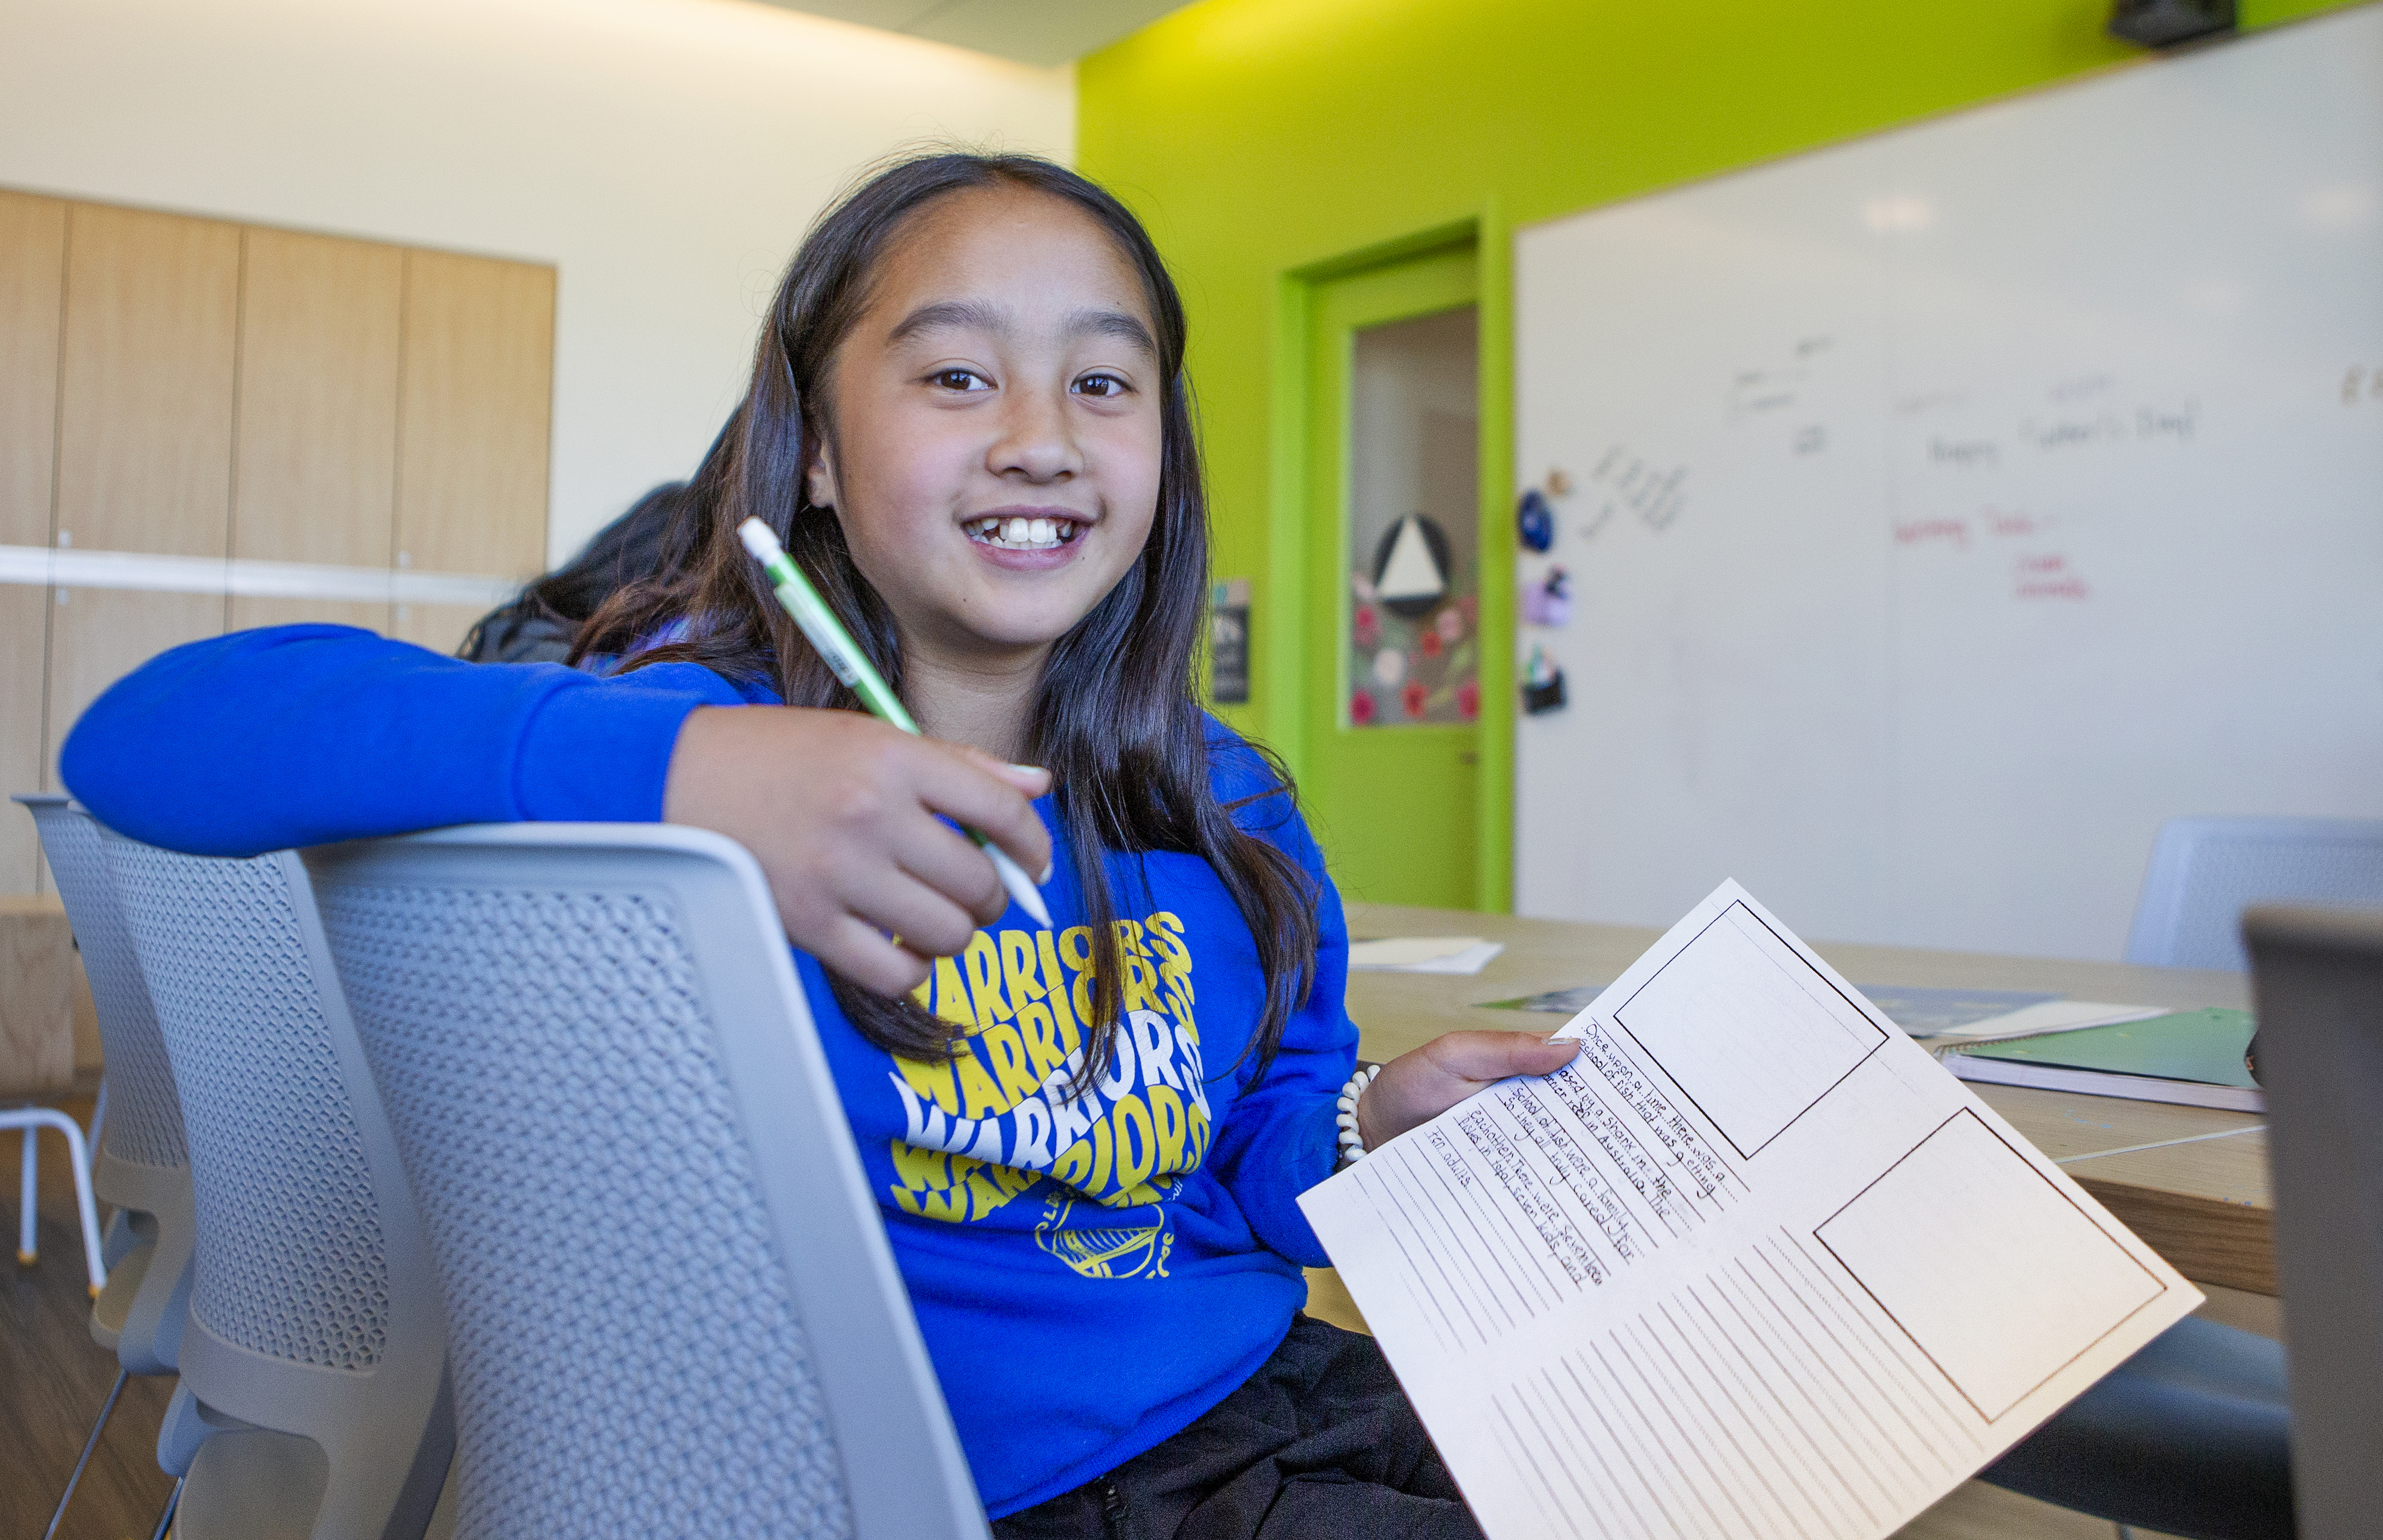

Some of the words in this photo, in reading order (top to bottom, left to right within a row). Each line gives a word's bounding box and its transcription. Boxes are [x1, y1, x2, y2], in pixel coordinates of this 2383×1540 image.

[910, 911, 1193, 1035] ARRIORS
[1504, 1096, 1514, 1111] So
[1514, 1111, 1535, 1141] they
[1534, 1135, 1552, 1149] all
[1542, 1075, 1567, 1099] arrier
[1587, 1121, 1599, 1133] in
[1648, 1194, 1670, 1219] The
[1581, 1093, 1595, 1112] by
[1595, 1109, 1603, 1117] a
[1653, 1172, 1672, 1201] the
[1586, 1023, 1609, 1050] Once
[1608, 1052, 1633, 1080] upon
[1634, 1081, 1642, 1091] a
[1643, 1088, 1666, 1114] time
[1668, 1115, 1694, 1146] there
[1693, 1147, 1716, 1171] was
[1716, 1172, 1726, 1182] a
[1604, 1069, 1619, 1080] of
[1617, 1079, 1634, 1102] fish
[1636, 1101, 1658, 1124] that
[1654, 1126, 1677, 1148] was
[1480, 1144, 1491, 1158] in
[1566, 1148, 1591, 1176] were
[1588, 1177, 1598, 1189] a
